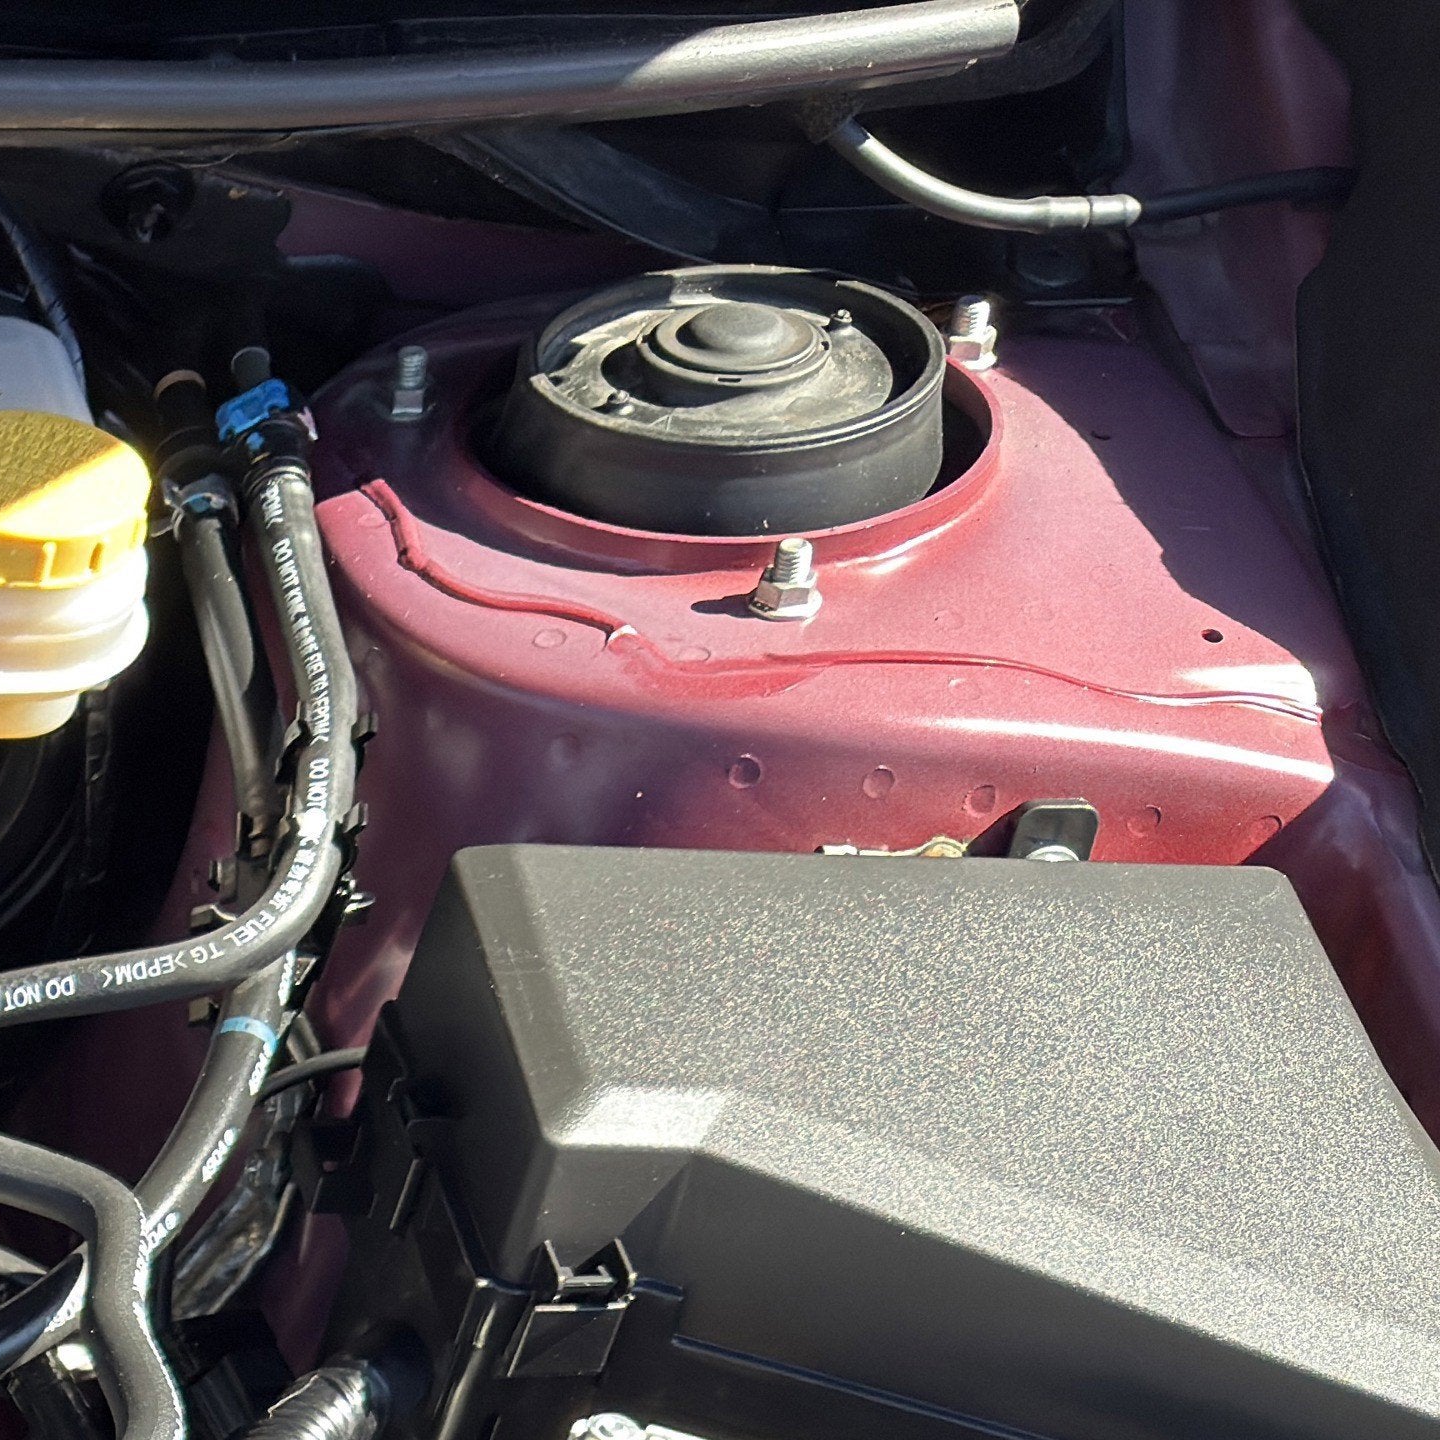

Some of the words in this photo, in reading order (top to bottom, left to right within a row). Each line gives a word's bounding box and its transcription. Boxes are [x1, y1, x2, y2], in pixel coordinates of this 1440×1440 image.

[223, 908, 274, 946] FUEL
[188, 937, 225, 964] TG
[1, 982, 40, 1011] NOT
[44, 973, 76, 1000] DO
